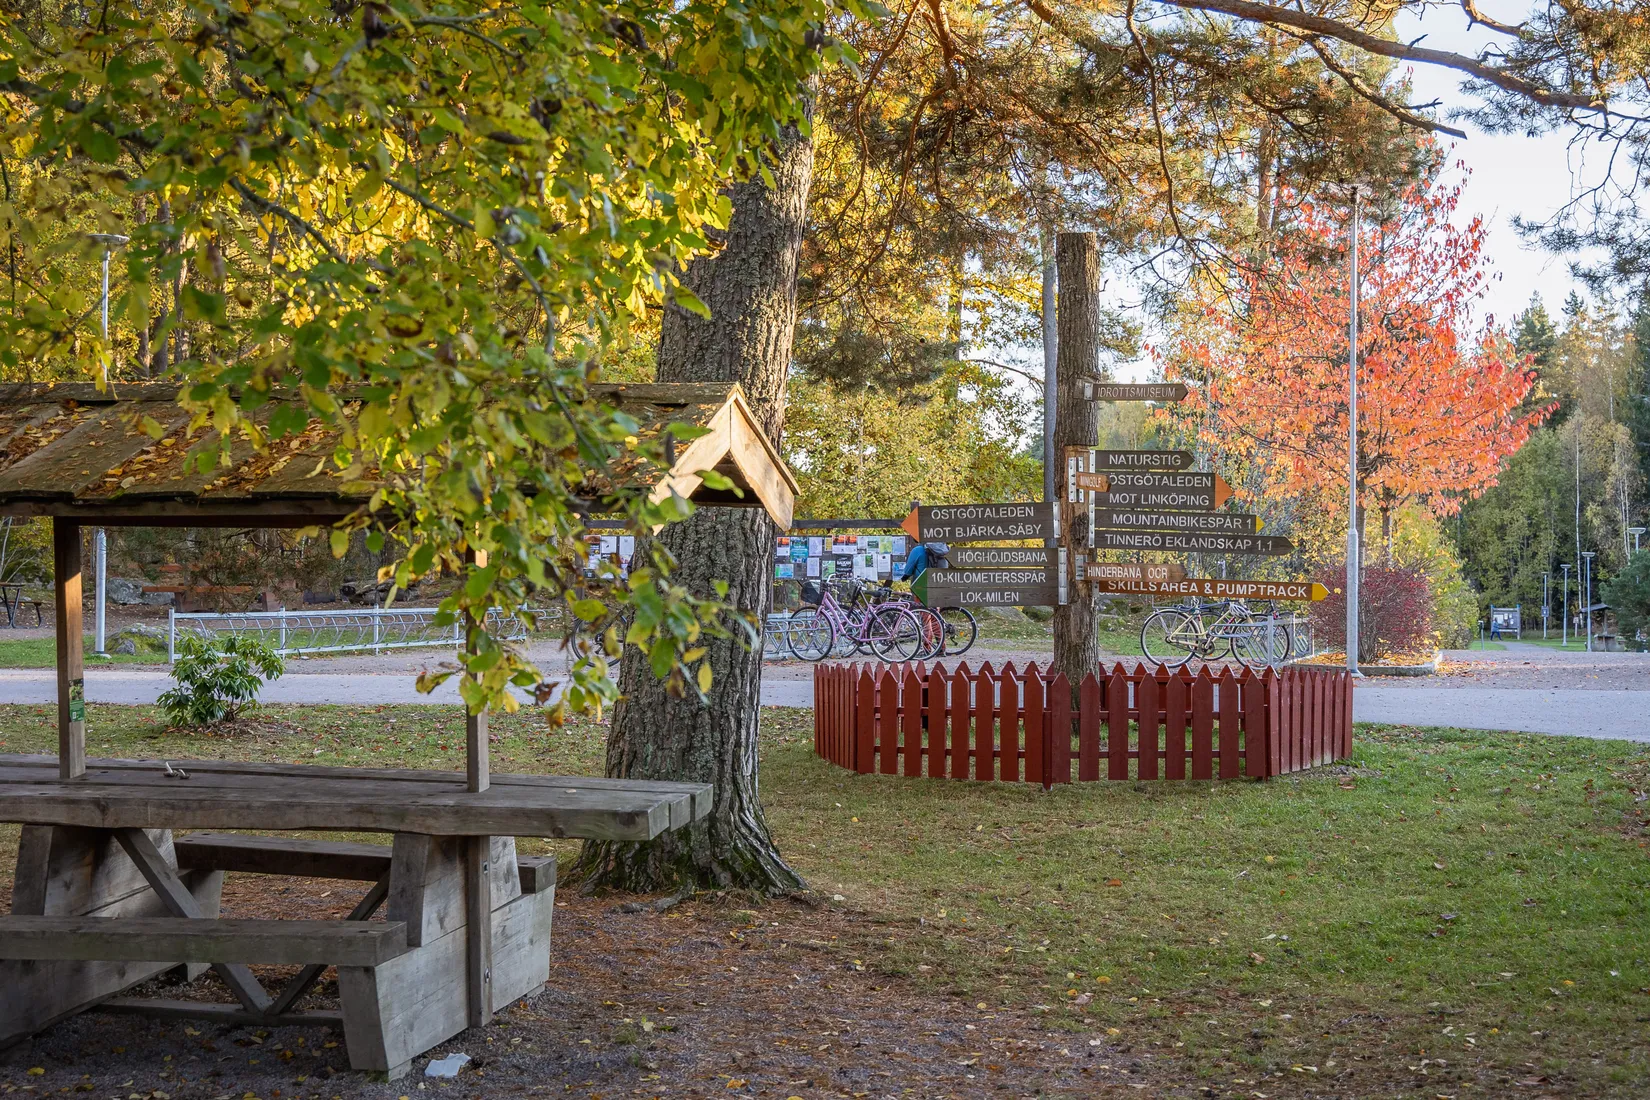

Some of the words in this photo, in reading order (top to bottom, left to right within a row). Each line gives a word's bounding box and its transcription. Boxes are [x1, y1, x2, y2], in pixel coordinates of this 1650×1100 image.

[1097, 386, 1176, 398] IDROTTSMUSEUM
[1109, 453, 1181, 466] NATURSTIG
[1109, 472, 1212, 488] ÖSTGÖTALEDEN
[1109, 492, 1137, 504] MOT
[1141, 492, 1209, 506] LINKÖPING
[931, 506, 1034, 520] ÖSTGÖTALEDEN
[1112, 513, 1242, 530] MOUNTAINBIKESPÅR
[1246, 518, 1252, 529] 1
[923, 527, 951, 538] MOT
[955, 523, 1042, 538] BJÄRKA-SÄBY
[1104, 533, 1162, 547] TINNERÖ
[1165, 536, 1252, 550] EKLANDSKAP
[1256, 540, 1273, 553] 1,1
[957, 549, 1048, 563] HÖGHÖJDSBANA
[931, 571, 1046, 584] 10-KILOMETERSSPÅR
[1087, 565, 1142, 579] HINDERBANA
[1147, 567, 1168, 579] OCR
[1108, 581, 1157, 592] SKILLS
[1160, 582, 1199, 594] AREA
[1204, 583, 1213, 594] &
[1216, 583, 1308, 598] PUMPTRACK
[960, 591, 1019, 603] LOK-MILEN
